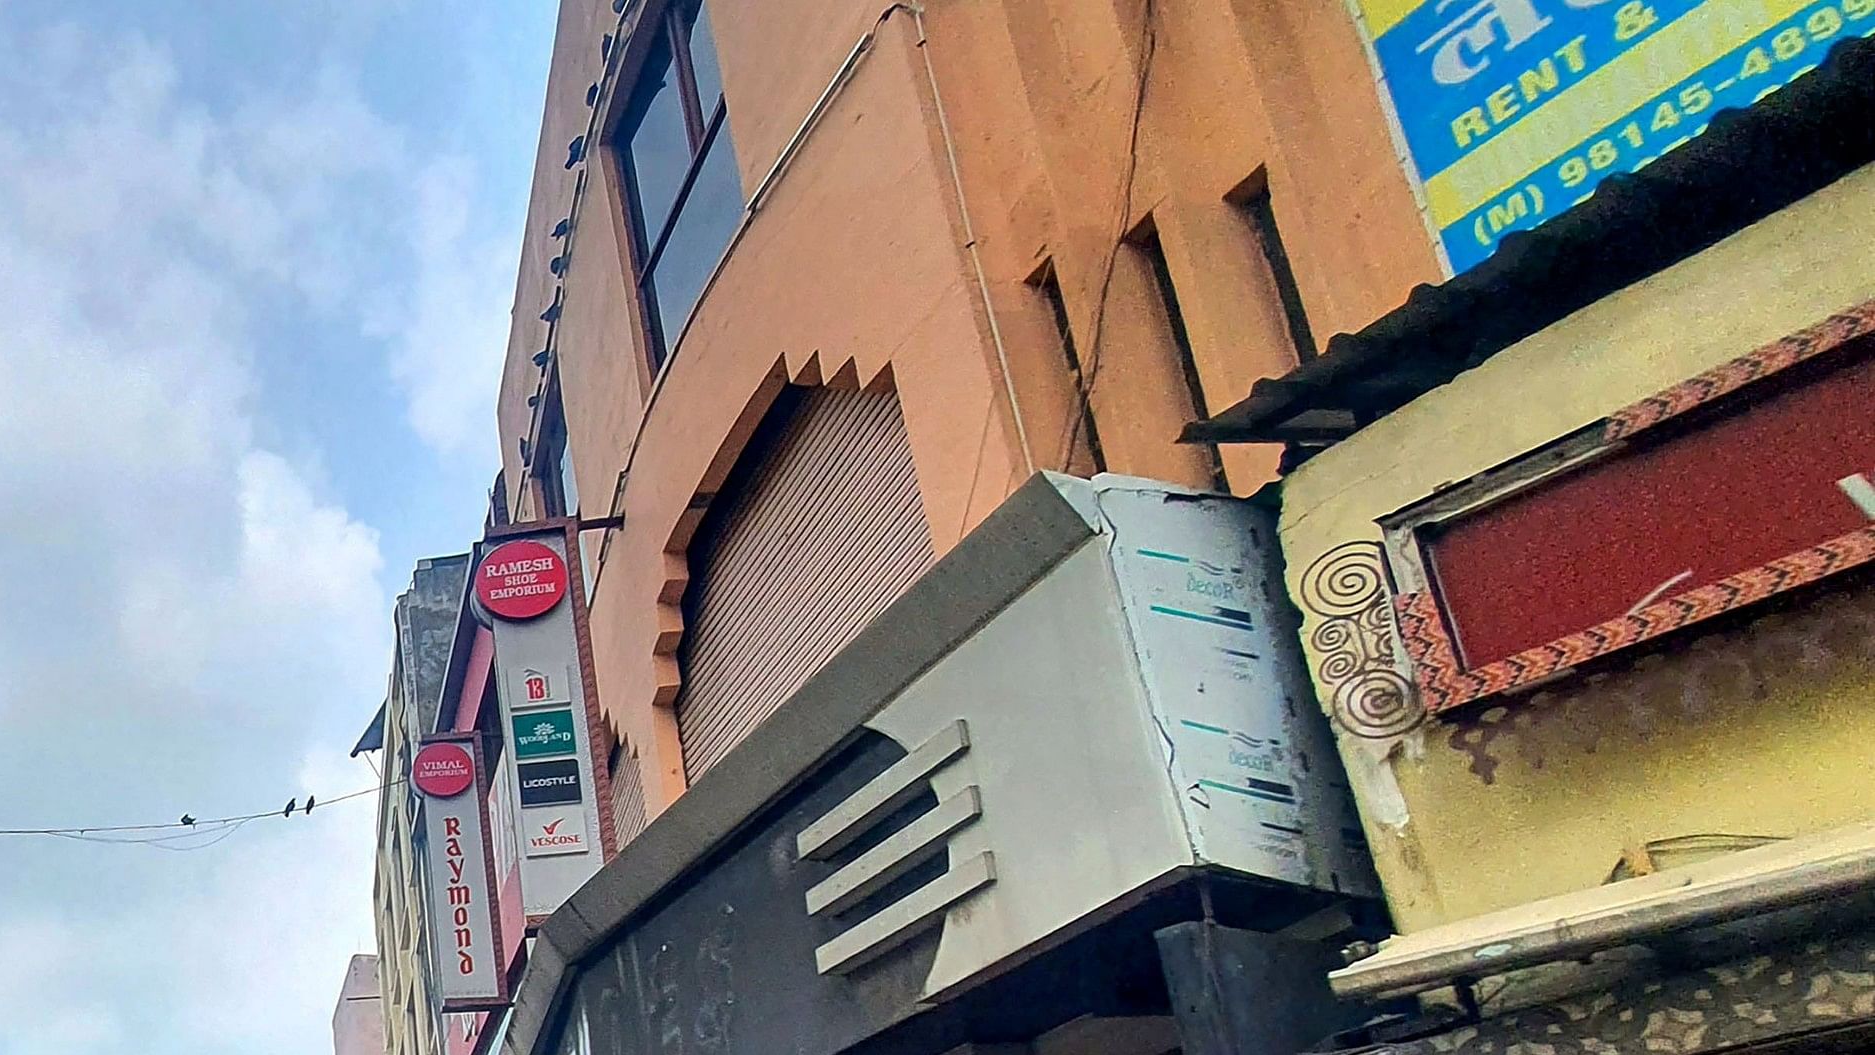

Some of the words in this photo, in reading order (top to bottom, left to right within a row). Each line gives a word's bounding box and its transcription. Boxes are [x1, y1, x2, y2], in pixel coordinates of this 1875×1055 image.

[1451, 34, 1587, 148] RENT
[1614, 0, 1659, 41] &
[1473, 183, 1545, 247] (M)
[485, 557, 554, 577] RAMESH
[504, 573, 538, 587] SHOE
[490, 582, 556, 600] EMPORIUM
[423, 760, 464, 770] VIMAL
[531, 834, 581, 848] VESCOSE
[443, 816, 474, 976] Raymond
